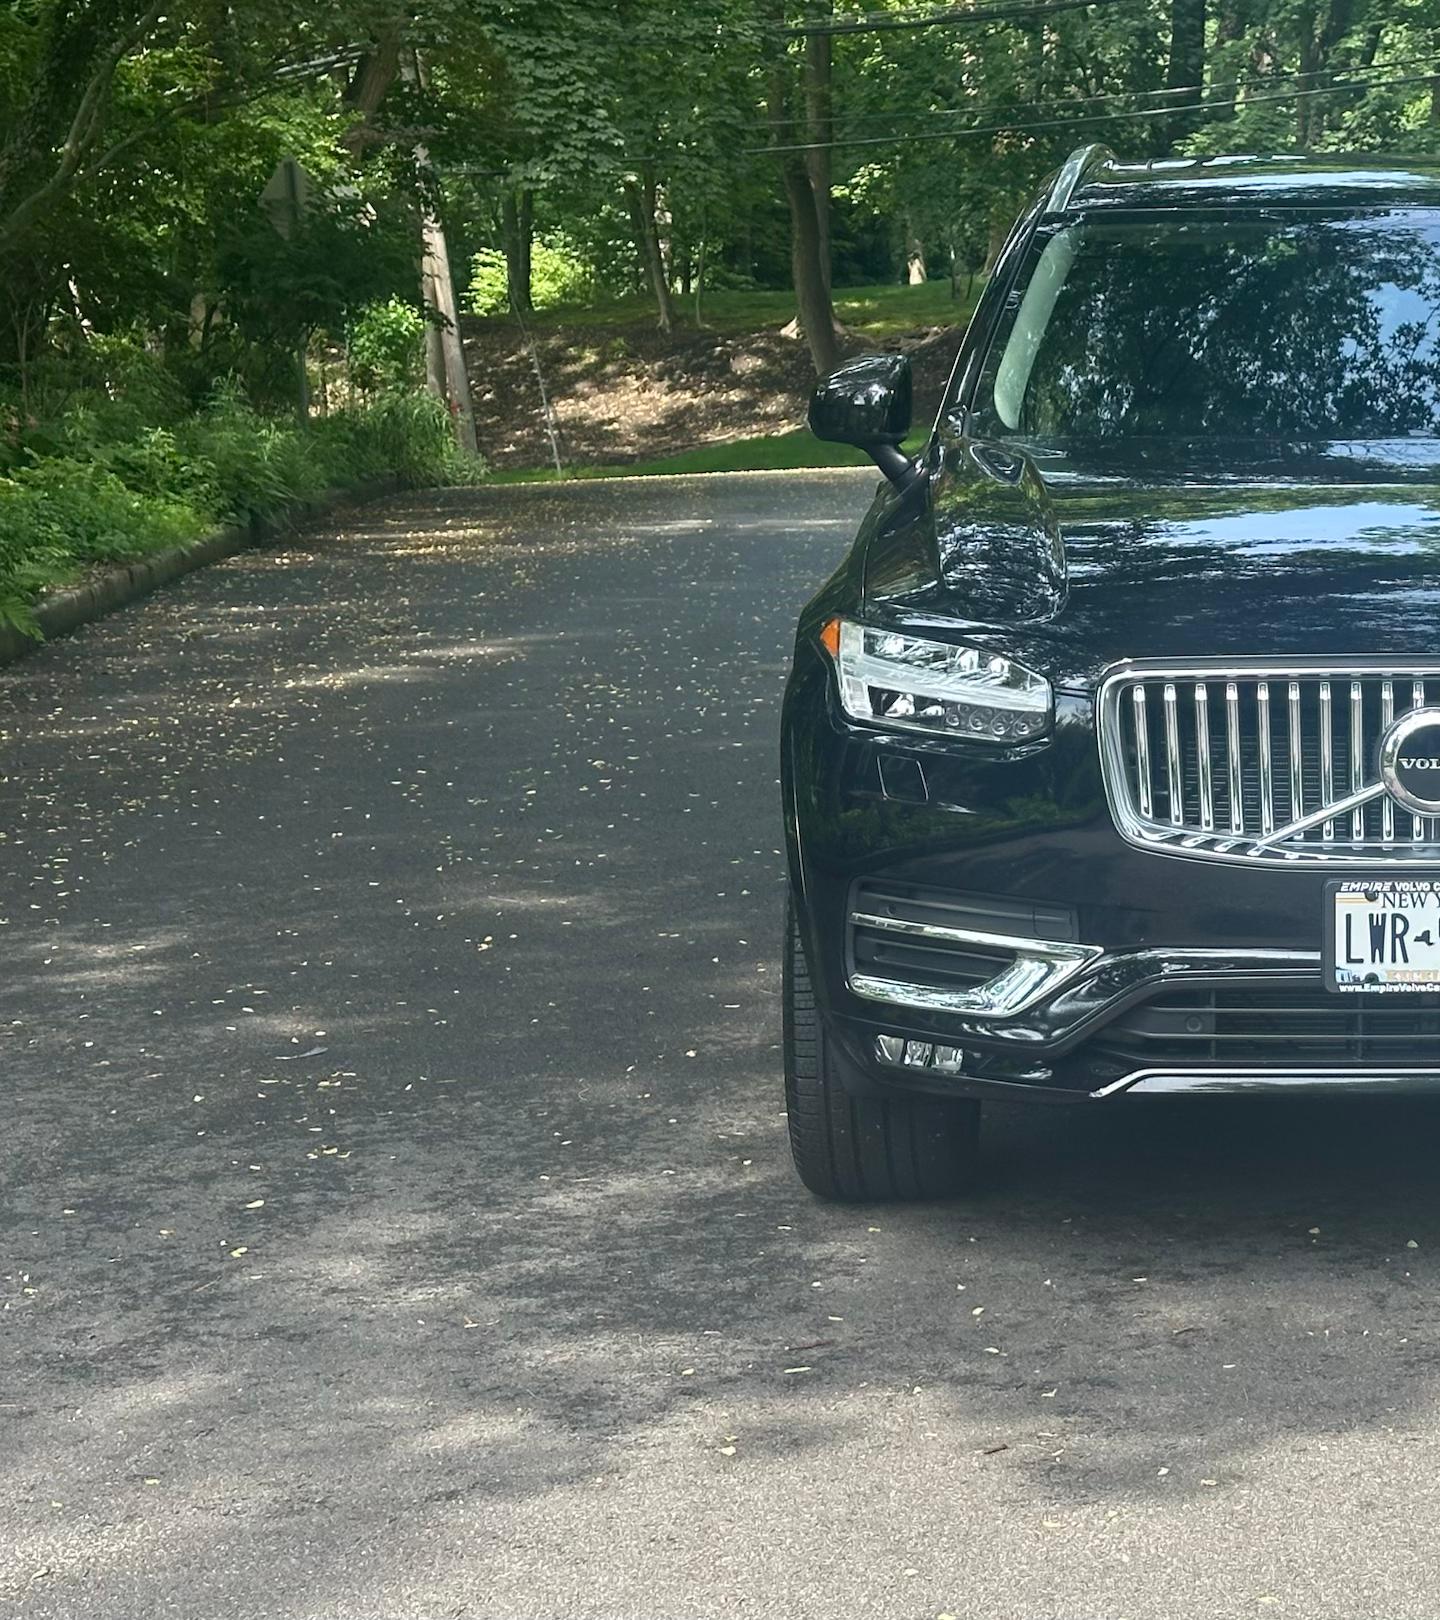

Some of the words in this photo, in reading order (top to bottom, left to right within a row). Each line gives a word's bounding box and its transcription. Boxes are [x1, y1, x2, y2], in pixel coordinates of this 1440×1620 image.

[1340, 882, 1392, 891] EMPIRE
[1395, 882, 1430, 891] VOLVO
[1381, 893, 1428, 908] NEW
